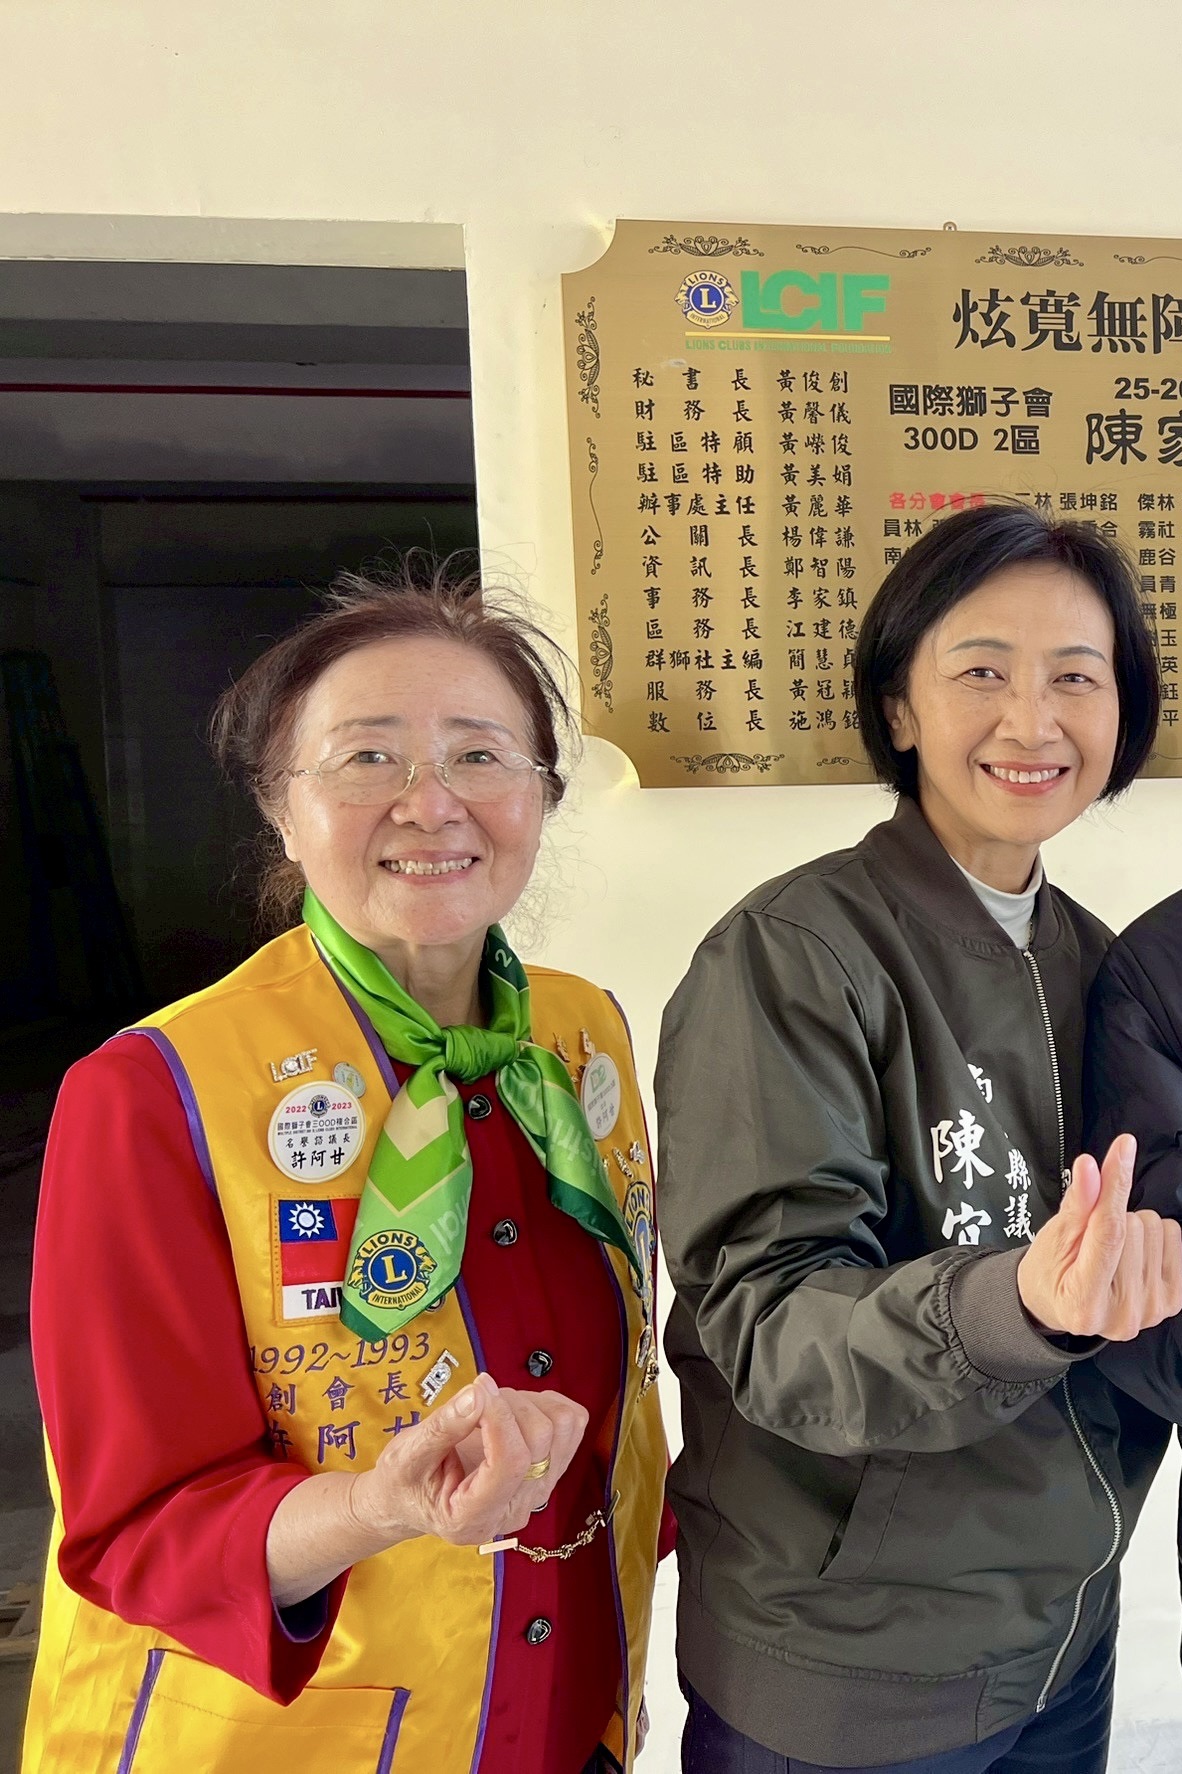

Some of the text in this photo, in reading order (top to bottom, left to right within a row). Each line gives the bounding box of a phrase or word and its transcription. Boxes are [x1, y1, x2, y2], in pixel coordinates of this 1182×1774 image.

[688, 272, 725, 287] LIONS
[700, 288, 717, 309] L
[740, 269, 891, 331] LCIF
[633, 367, 848, 393] 秘書長 黃俊創
[635, 398, 851, 425] 財務長 黃馨儀
[889, 384, 1053, 418] 國際獅子會
[635, 430, 755, 454] 駐區特顧
[904, 424, 1040, 455] 300D 2區
[636, 462, 852, 487] 駐區特助 黃美娟
[781, 495, 853, 518] 黃麗華
[1060, 492, 1118, 511] 張坤銘
[1138, 493, 1175, 512] 傑林
[640, 524, 855, 549] 公關長 楊偉謙
[883, 519, 923, 538] 員林
[1138, 521, 1176, 539] 霧社
[642, 555, 856, 579] 資訊長 鄭智陽
[1138, 548, 1176, 566] 鹿谷
[1140, 575, 1177, 594] 員青
[643, 586, 858, 610] 事務長 李家鎮
[646, 617, 859, 641] 區務長 江建德
[645, 648, 763, 672] 群獅社主編
[646, 679, 765, 702] 服務長
[647, 710, 766, 733] 數位長
[285, 1102, 353, 1114] 2022 2023
[291, 1147, 345, 1170] 許阿甘
[362, 1232, 414, 1256] LIONS
[381, 1254, 408, 1284] L
[301, 1288, 343, 1311] TAI
[372, 1286, 423, 1305] INTERNATIONAL
[266, 1370, 411, 1415] 創會長
